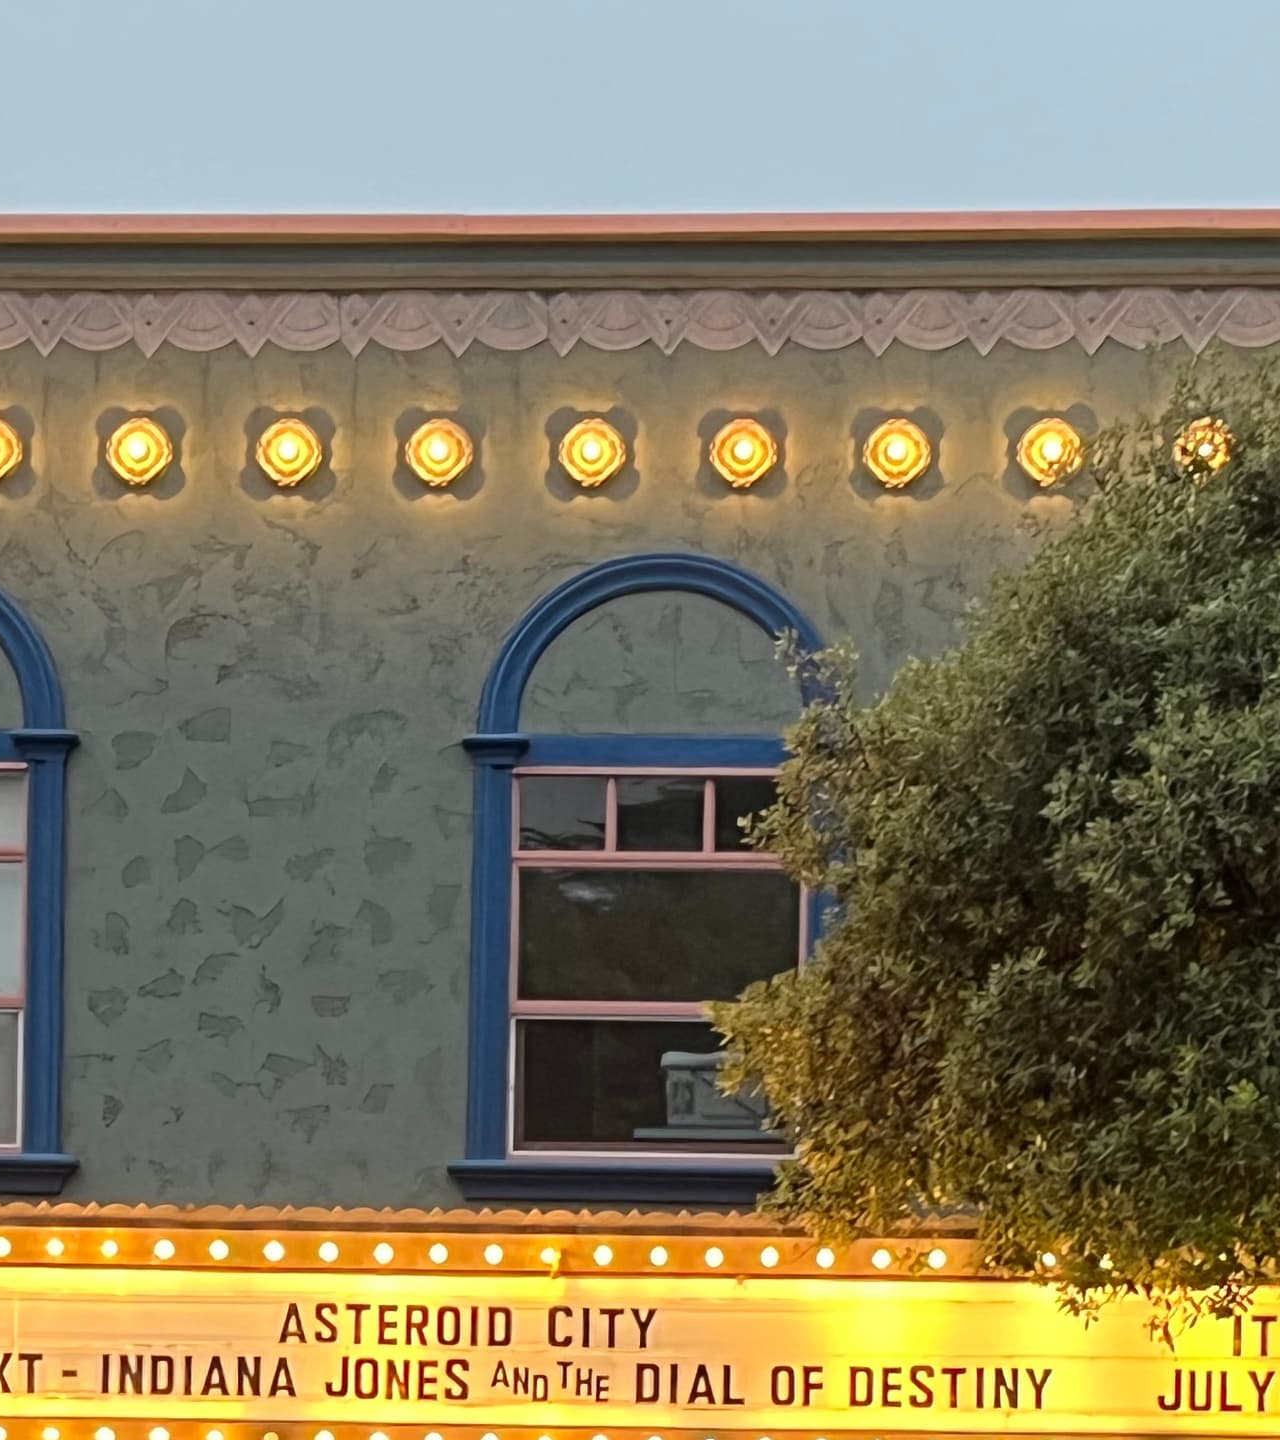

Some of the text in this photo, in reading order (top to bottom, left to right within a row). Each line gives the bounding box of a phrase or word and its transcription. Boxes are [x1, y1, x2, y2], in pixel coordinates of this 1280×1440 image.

[278, 1302, 659, 1350] ASTEROID CITY
[101, 1353, 297, 1399] INDIANA
[324, 1356, 471, 1401] JONES
[491, 1360, 549, 1402] AND
[556, 1361, 610, 1402] THE
[635, 1362, 746, 1407] DIAL
[770, 1365, 824, 1408] OF
[848, 1365, 1053, 1411] DESTINY
[1157, 1369, 1275, 1413] JULY
